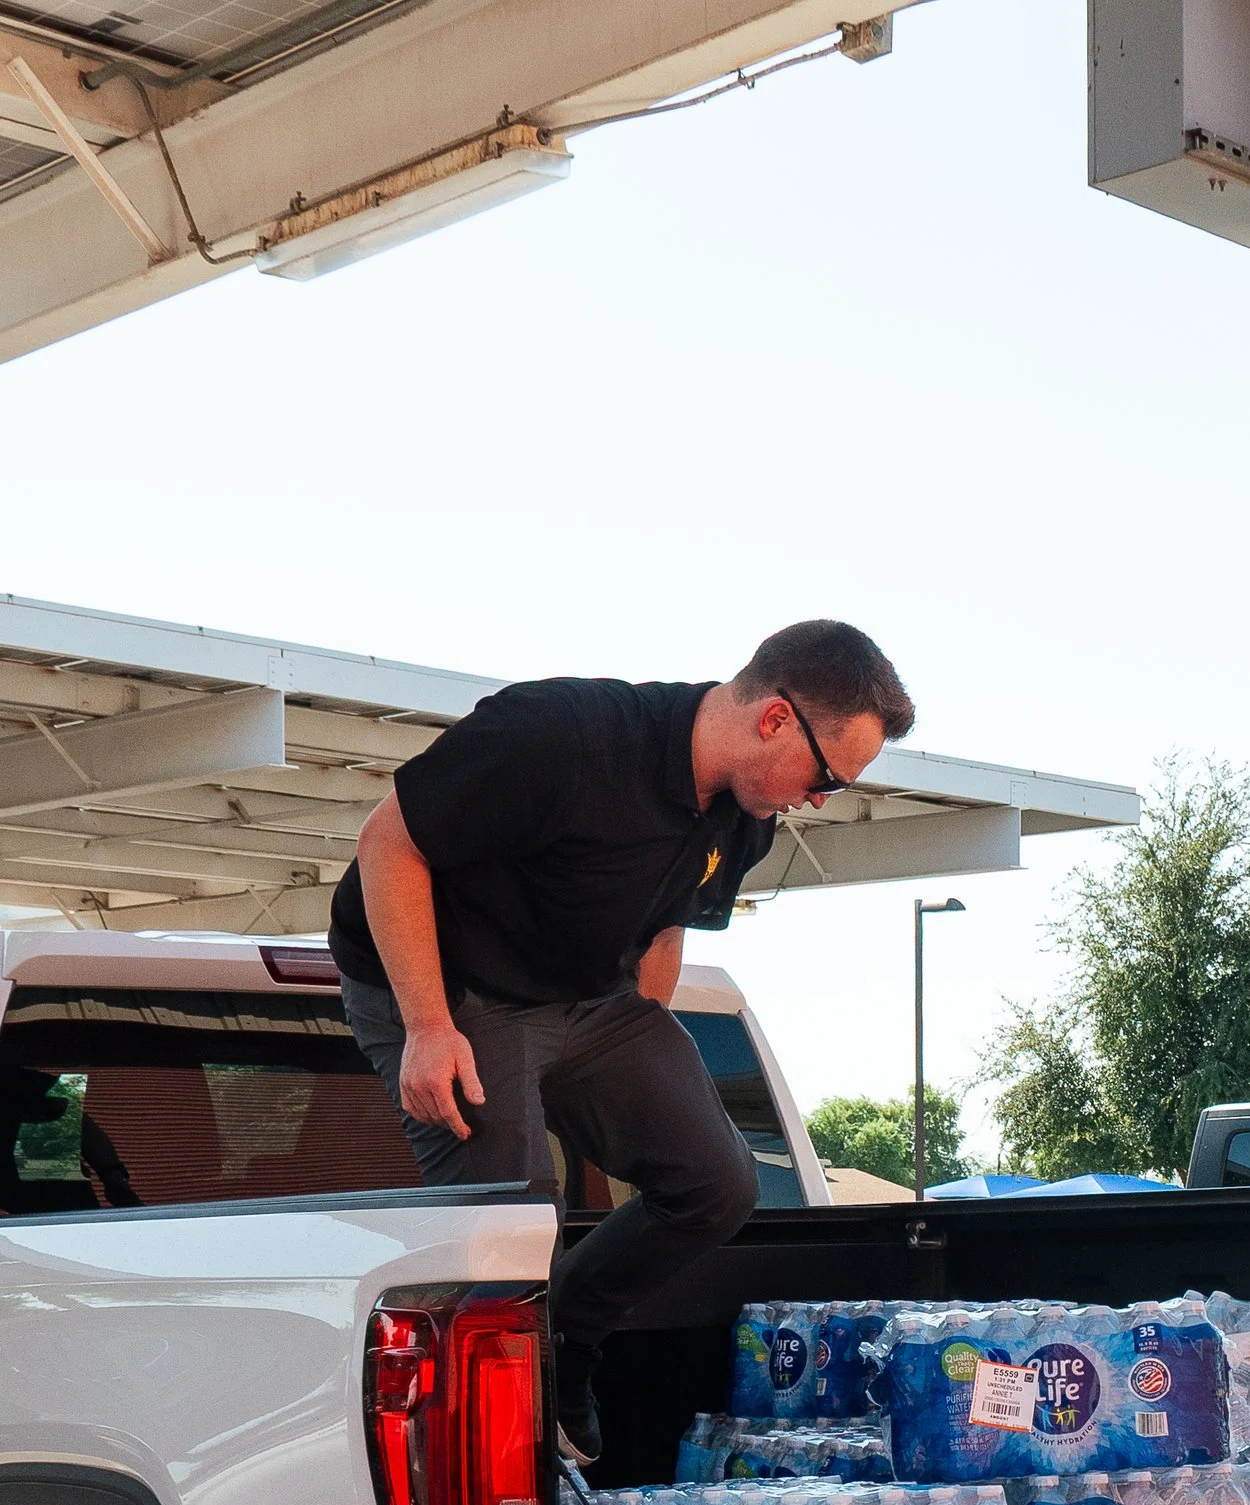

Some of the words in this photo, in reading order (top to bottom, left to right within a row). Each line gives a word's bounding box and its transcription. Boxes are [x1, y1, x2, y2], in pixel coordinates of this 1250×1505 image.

[1138, 1326, 1156, 1337] 35
[776, 1339, 801, 1352] ure
[774, 1351, 795, 1371] ife
[944, 1351, 980, 1363] Quality
[948, 1365, 975, 1376] Clear
[993, 1367, 1019, 1379] E5559
[987, 1382, 1024, 1393] UNSCHEDULED
[946, 1392, 974, 1405] PURIFIE
[1057, 1419, 1098, 1446] HYDRATION
